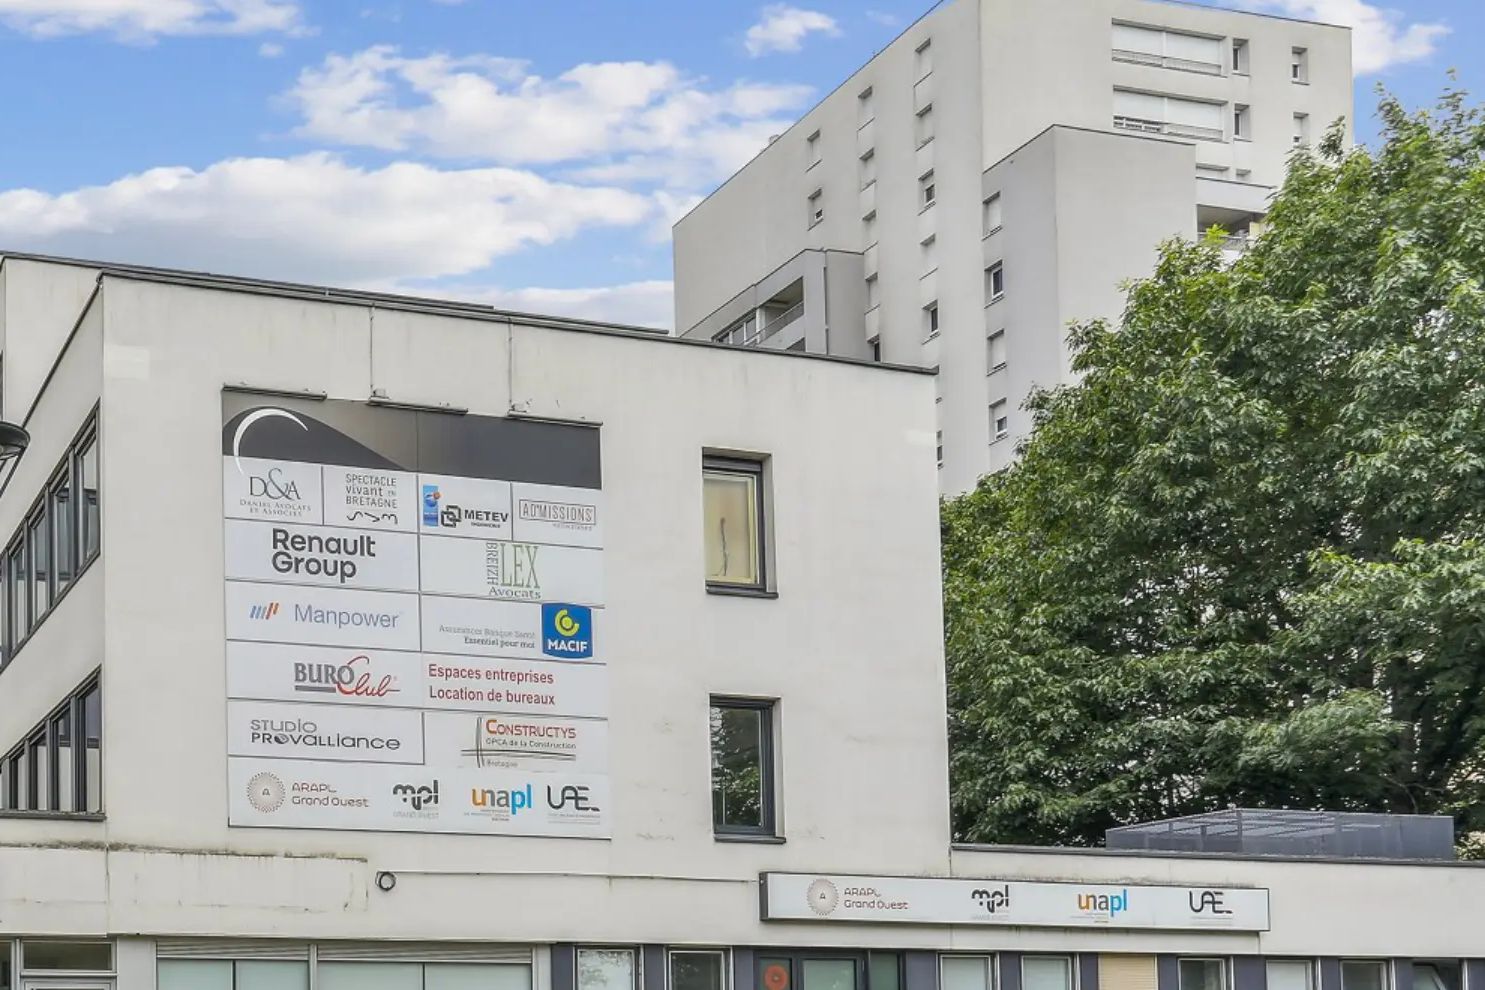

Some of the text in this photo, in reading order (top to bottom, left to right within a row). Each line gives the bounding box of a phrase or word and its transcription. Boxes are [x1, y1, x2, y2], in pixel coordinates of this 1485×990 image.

[249, 467, 301, 500] D&A
[346, 473, 397, 487] SPECTACLE
[346, 484, 383, 497] vivant
[346, 495, 398, 509] BRETAGNE
[464, 509, 509, 523] METEV
[272, 527, 376, 557] Renault
[272, 551, 357, 584] Group
[486, 541, 499, 586] BREIZH
[500, 543, 540, 589] LEX
[489, 586, 541, 599] Avocats
[294, 603, 399, 628] Manpower
[464, 636, 535, 649] Essentiel pour moi
[547, 638, 588, 653] MACIF
[294, 662, 354, 685] BURO
[429, 664, 554, 685] Espaces entreprises
[429, 685, 555, 705] Location de bureaux
[509, 739, 518, 747] de
[529, 740, 577, 750] Construction
[291, 795, 369, 808] Grand Ouest
[471, 783, 532, 815] unapl
[844, 899, 909, 910] Grand Ouest
[1078, 888, 1128, 918] unapl
